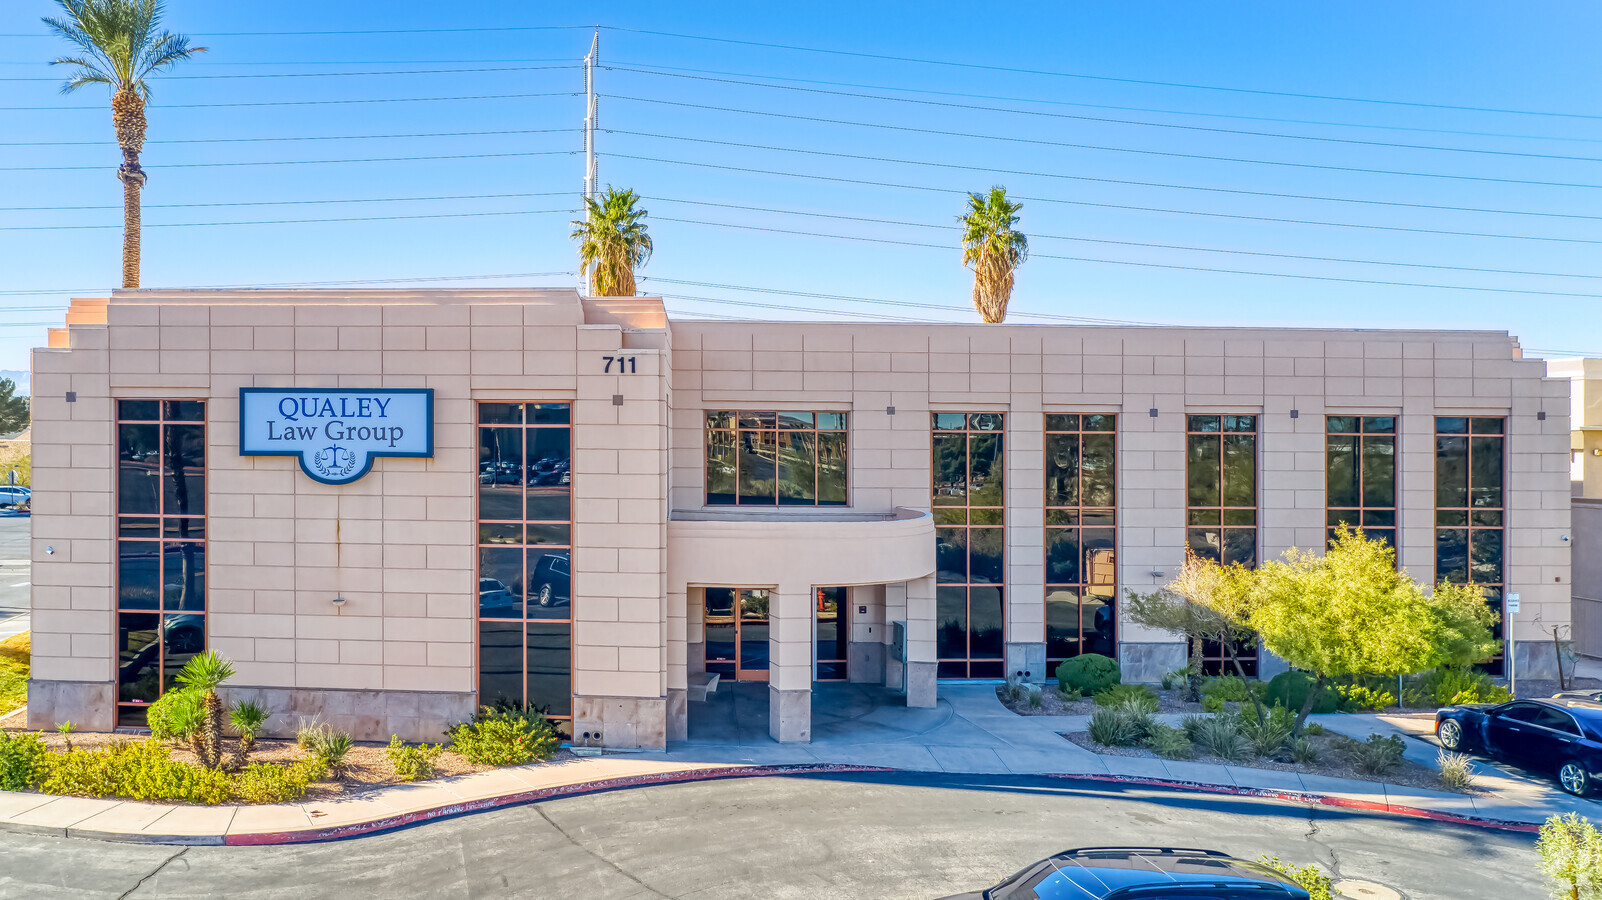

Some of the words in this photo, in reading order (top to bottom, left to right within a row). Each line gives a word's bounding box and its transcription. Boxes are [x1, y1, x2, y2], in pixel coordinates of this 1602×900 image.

[602, 356, 636, 374] 711
[278, 397, 392, 422] QUALEY
[266, 420, 318, 441] Law
[324, 420, 404, 447] Group
